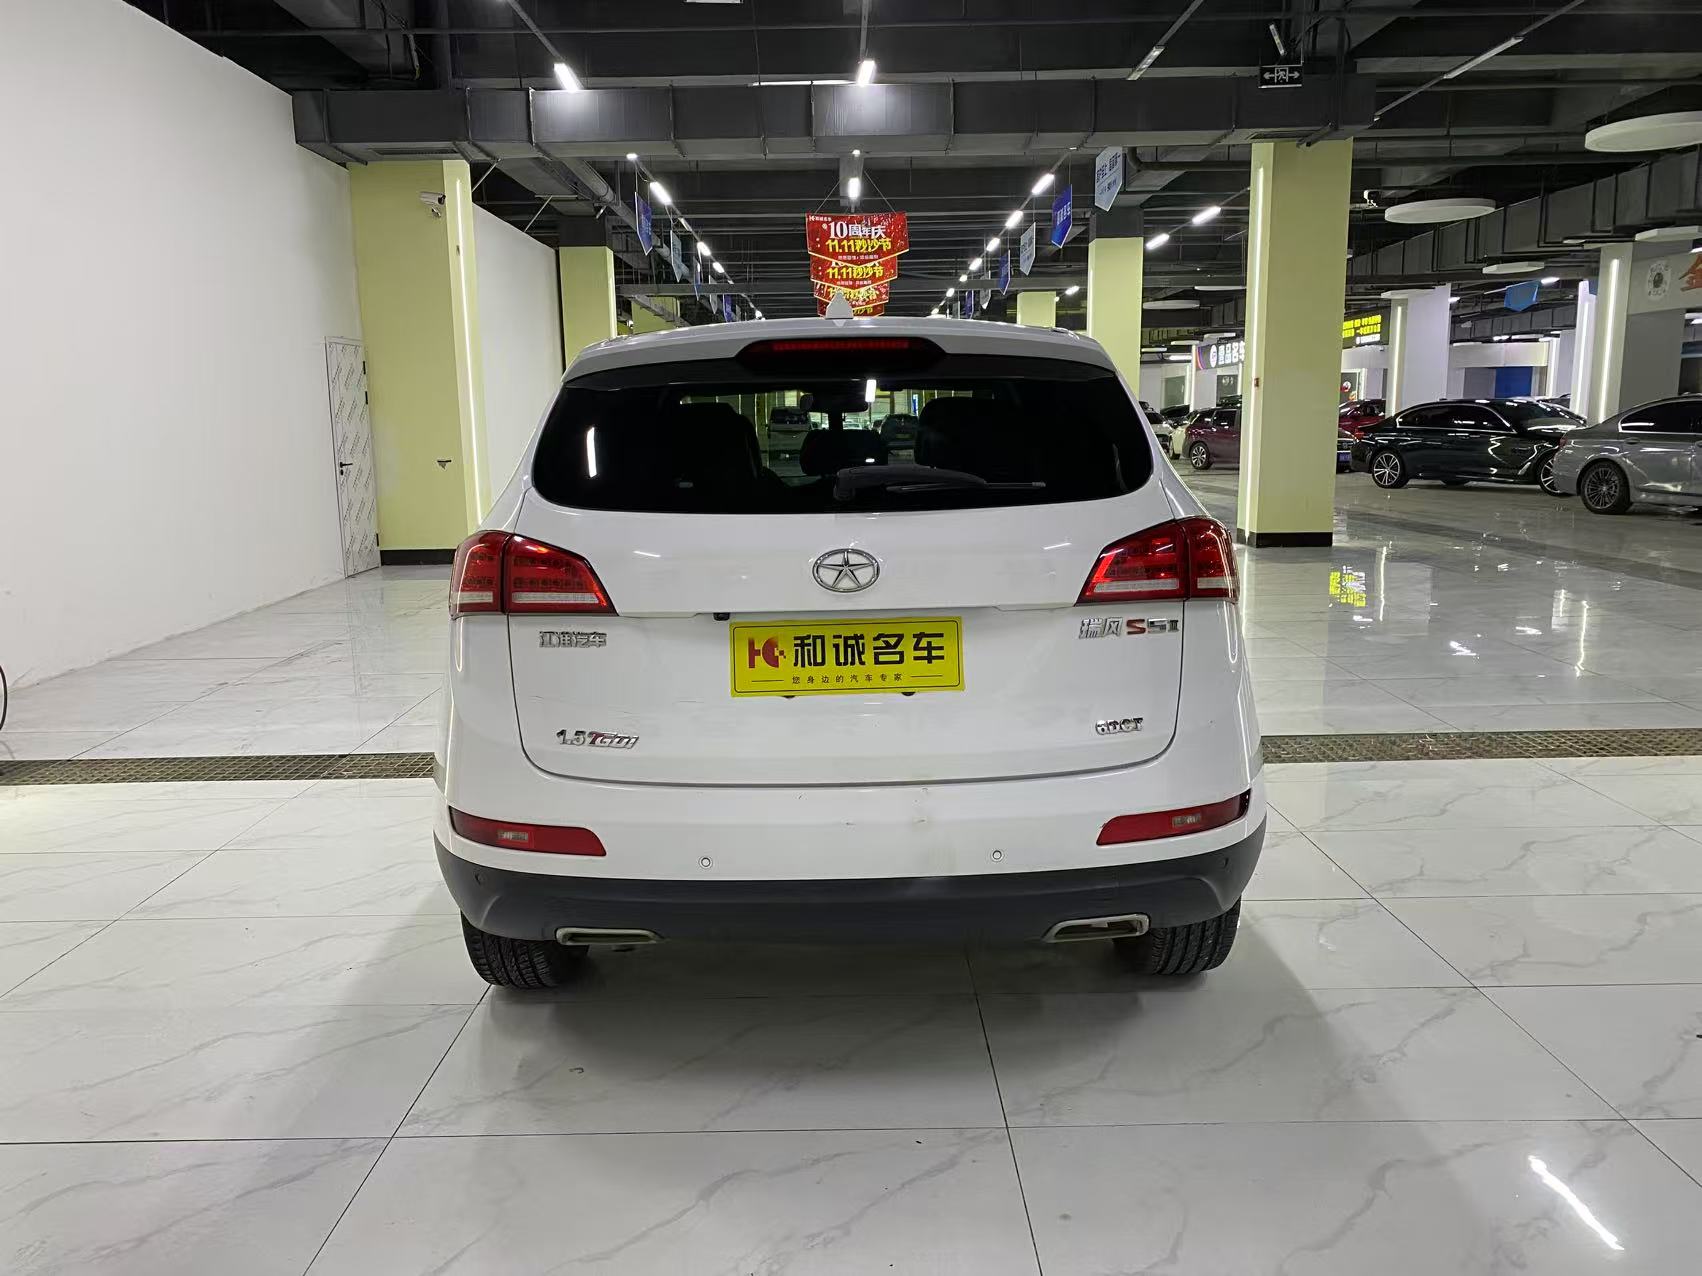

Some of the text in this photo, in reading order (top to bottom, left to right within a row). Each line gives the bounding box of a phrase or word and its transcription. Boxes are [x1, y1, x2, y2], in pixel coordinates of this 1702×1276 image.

[828, 221, 887, 239] 10周年庆
[793, 632, 945, 668] 和诚名车
[791, 673, 903, 685] 您身边的汽车专家
